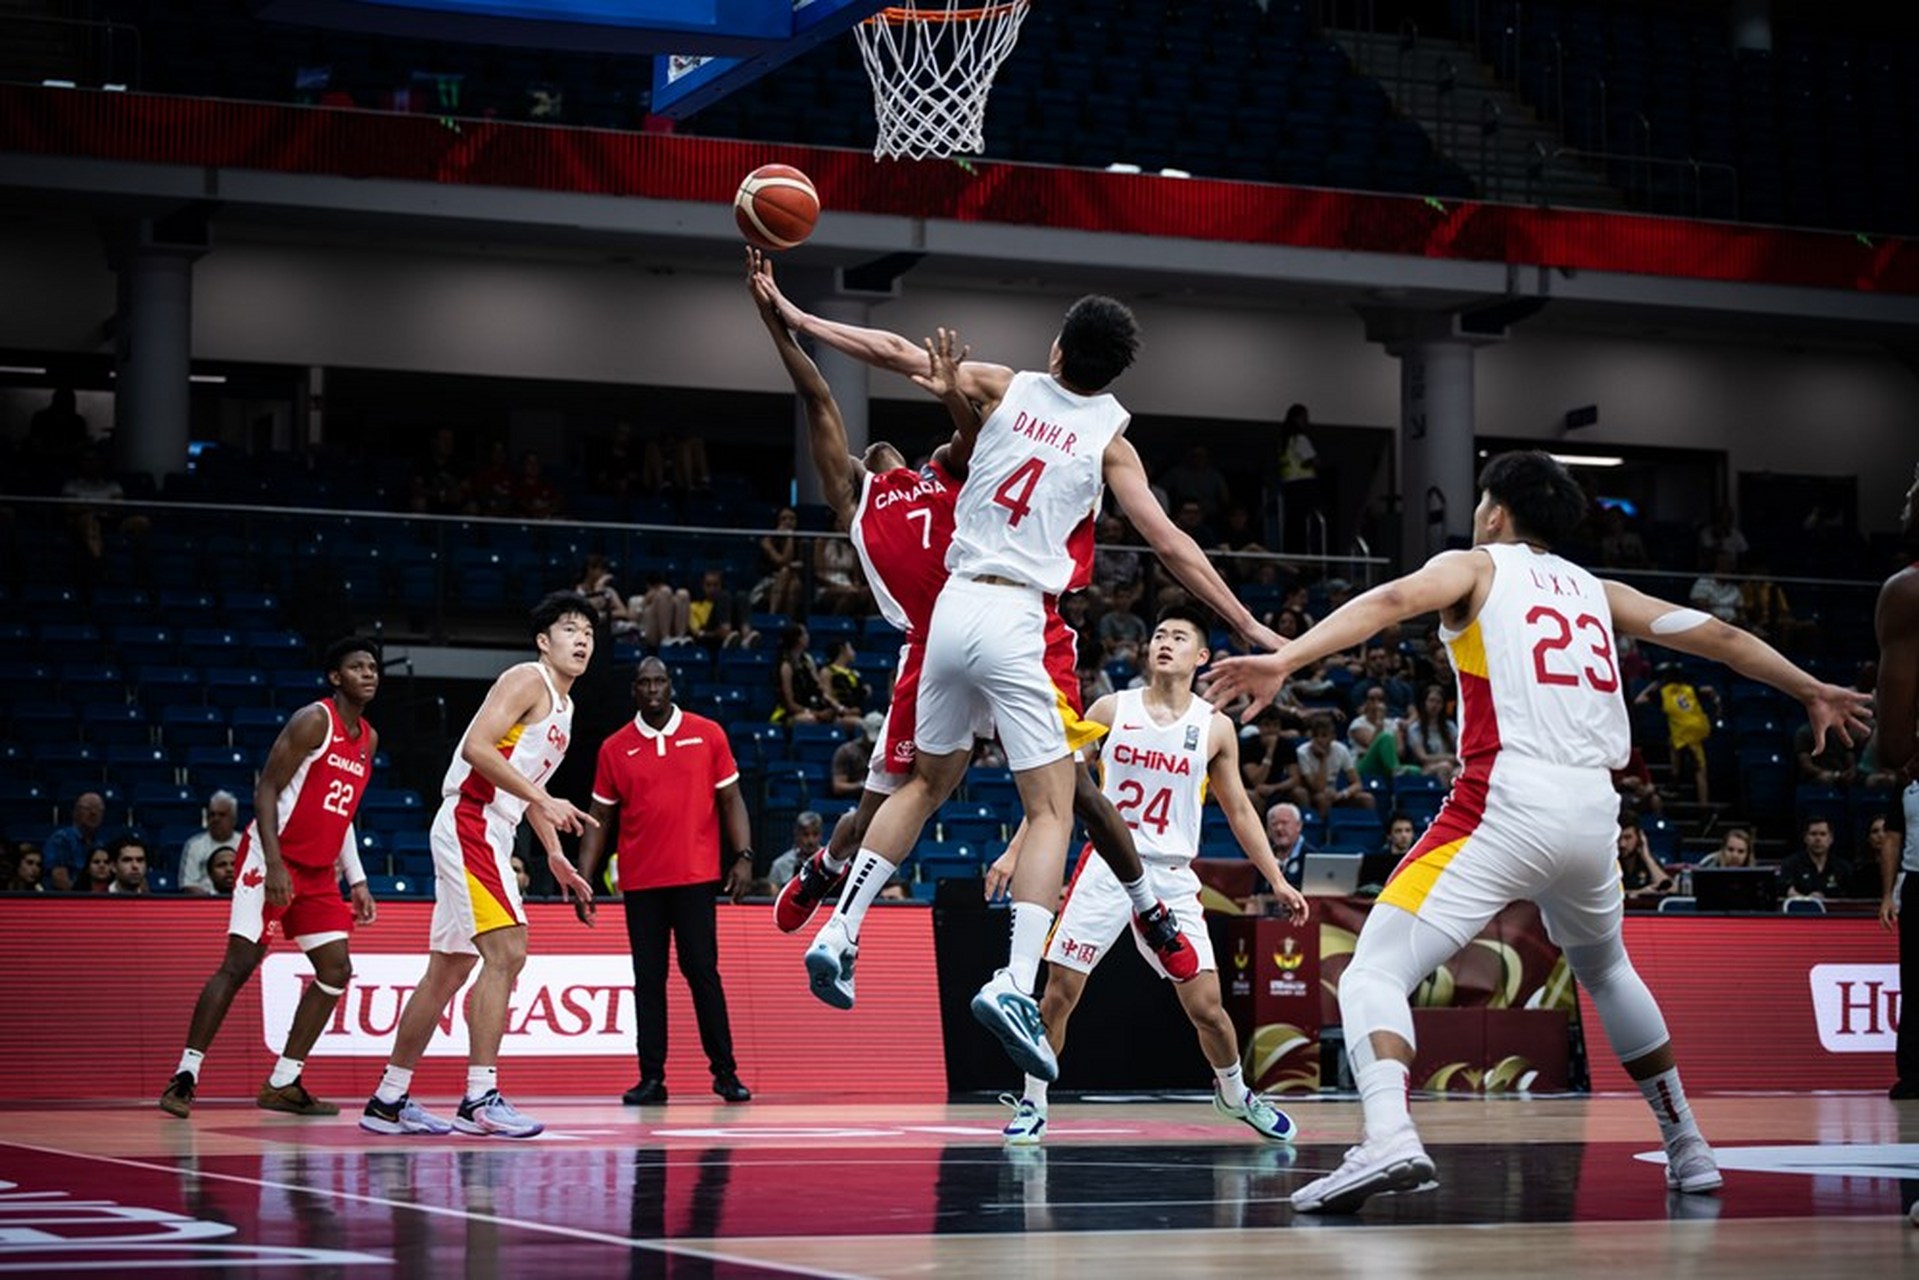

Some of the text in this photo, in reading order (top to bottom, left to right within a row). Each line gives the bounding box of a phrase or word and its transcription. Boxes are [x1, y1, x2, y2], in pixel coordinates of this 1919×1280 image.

[1012, 411, 1078, 457] DANH.R.
[875, 480, 947, 509] CANADA
[993, 456, 1047, 528] 4
[906, 507, 932, 549] 7
[1525, 605, 1619, 694] 23
[1114, 744, 1190, 776] CHINA
[322, 779, 354, 817] 22
[1116, 779, 1173, 836] 24
